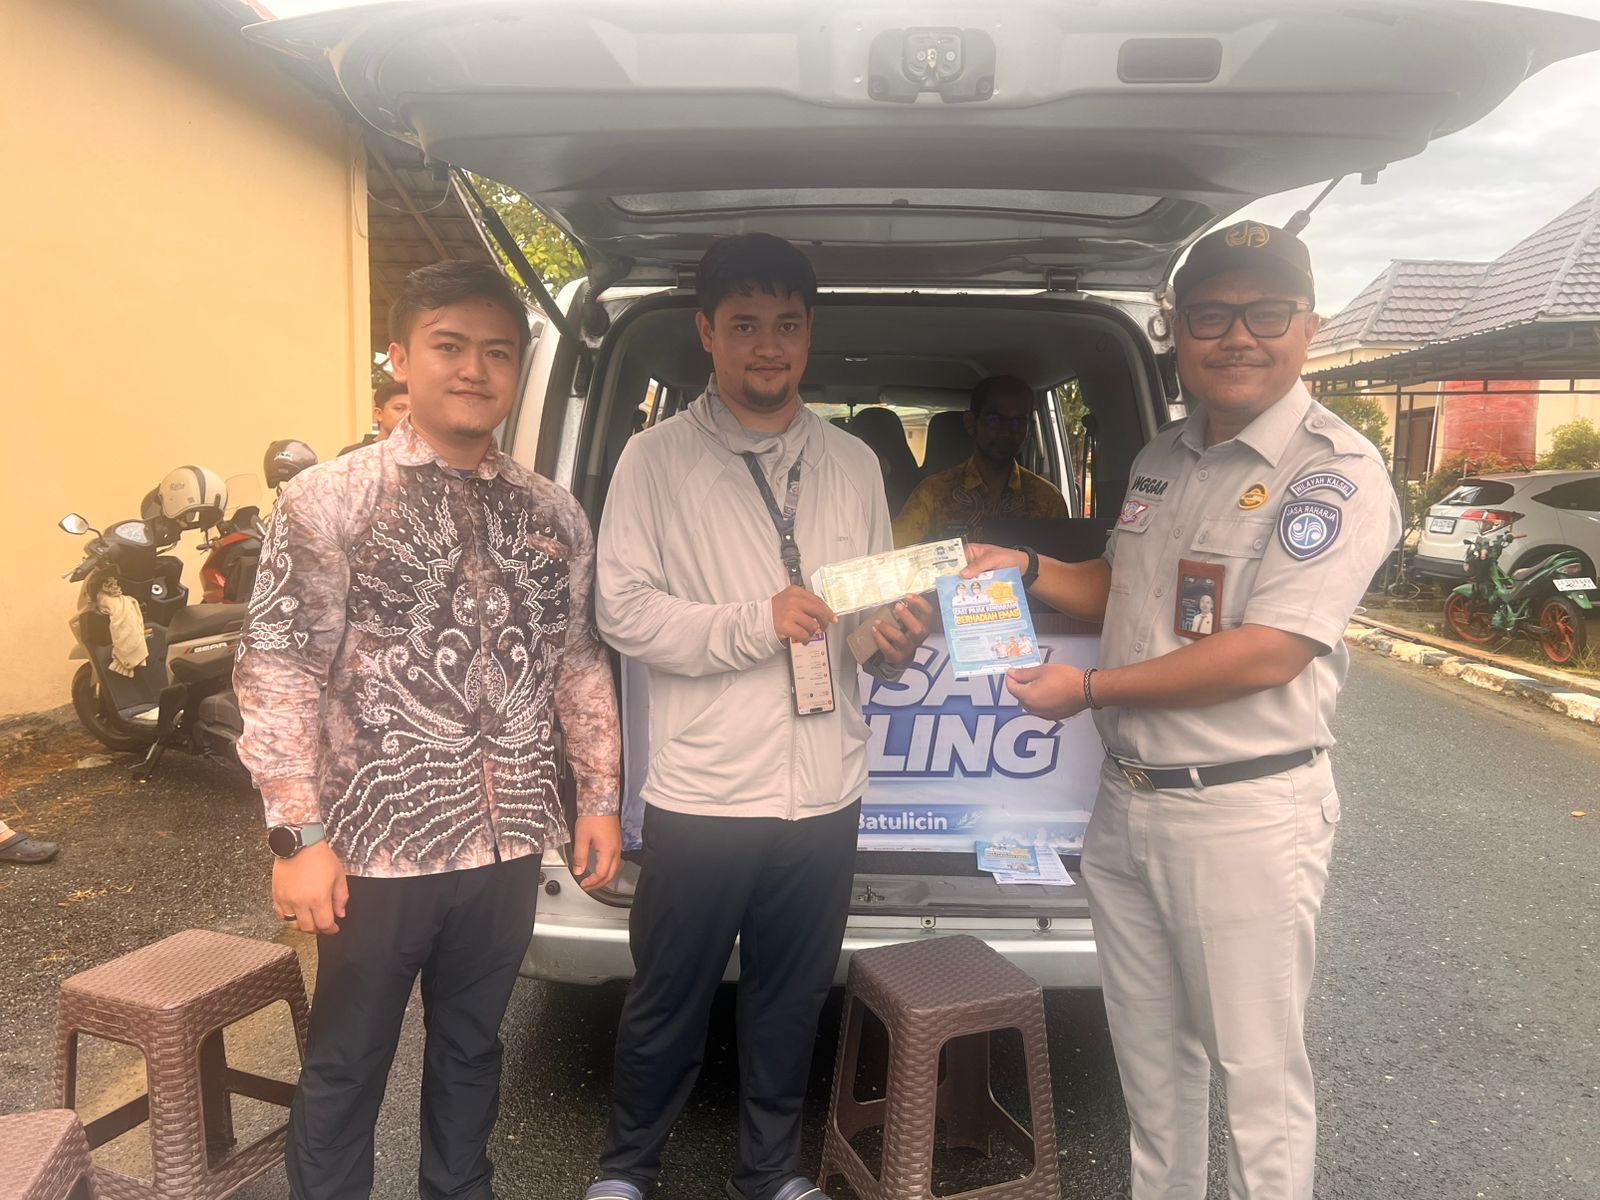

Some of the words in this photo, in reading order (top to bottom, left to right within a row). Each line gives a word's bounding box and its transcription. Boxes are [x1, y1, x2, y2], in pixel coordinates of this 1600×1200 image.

[1295, 477, 1325, 493] WILAYAH
[1326, 477, 1350, 495] KALSEL
[1286, 507, 1303, 517] JASA
[1304, 505, 1336, 522] RAHARJA
